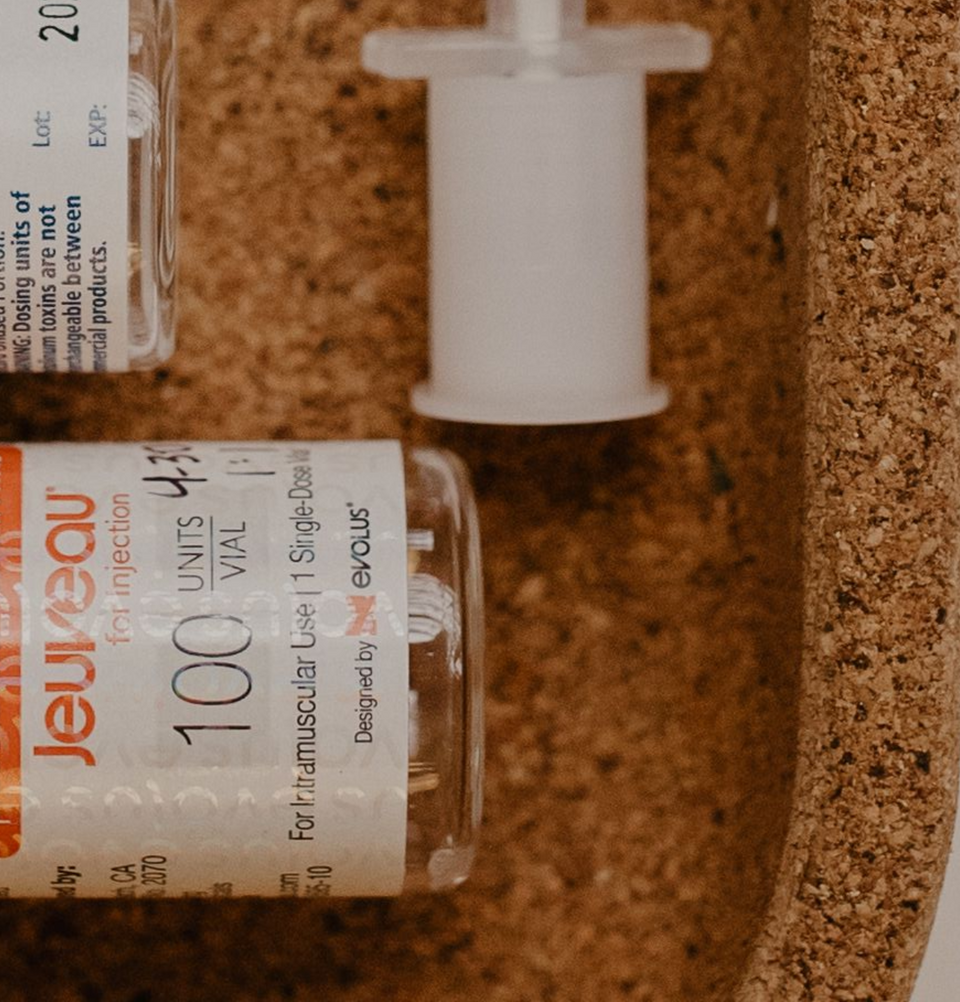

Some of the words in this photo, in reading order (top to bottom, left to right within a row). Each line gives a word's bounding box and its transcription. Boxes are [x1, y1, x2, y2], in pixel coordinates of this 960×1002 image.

[31, 110, 51, 147] Lot:
[88, 104, 107, 147] EXP:
[10, 190, 30, 213] of
[38, 204, 56, 241] not
[10, 220, 30, 270] units
[40, 247, 56, 279] are
[61, 195, 82, 285] between
[11, 277, 35, 332] Dosing
[87, 241, 112, 324] products.
[37, 285, 57, 332] toxins
[287, 465, 321, 563] Single-Dose
[105, 493, 138, 597] injection
[177, 515, 205, 592] UNITS
[219, 521, 246, 580] VIAL
[290, 573, 315, 582] 1
[105, 608, 131, 646] for
[290, 604, 317, 649] Use
[354, 641, 378, 661] by
[170, 614, 252, 746] 100
[354, 667, 378, 743] Designed
[289, 656, 316, 806] Intramuscular
[288, 812, 315, 841] For
[109, 863, 137, 883] CA
[141, 855, 167, 886] 2070
